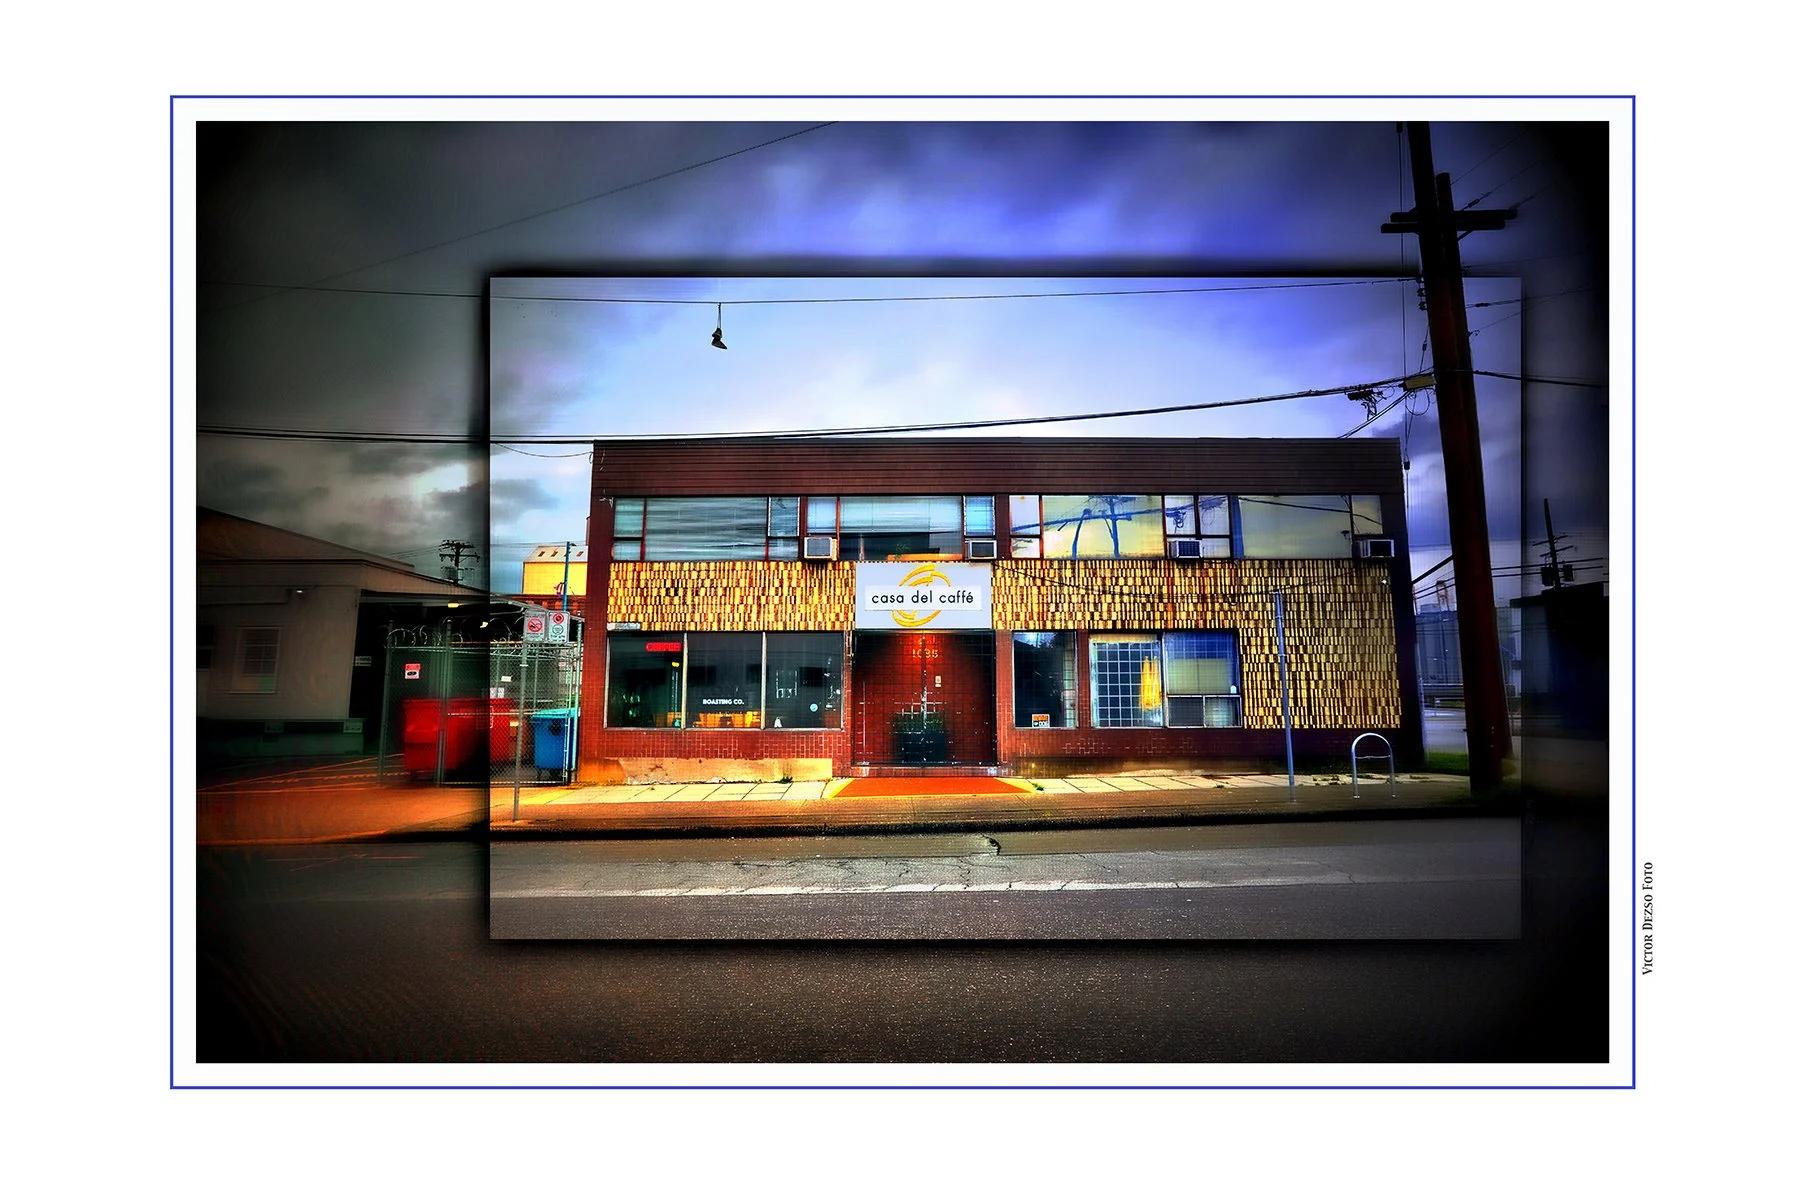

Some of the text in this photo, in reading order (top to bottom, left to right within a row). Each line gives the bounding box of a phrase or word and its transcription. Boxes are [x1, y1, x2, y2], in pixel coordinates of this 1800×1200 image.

[871, 590, 974, 604] casa del caffé
